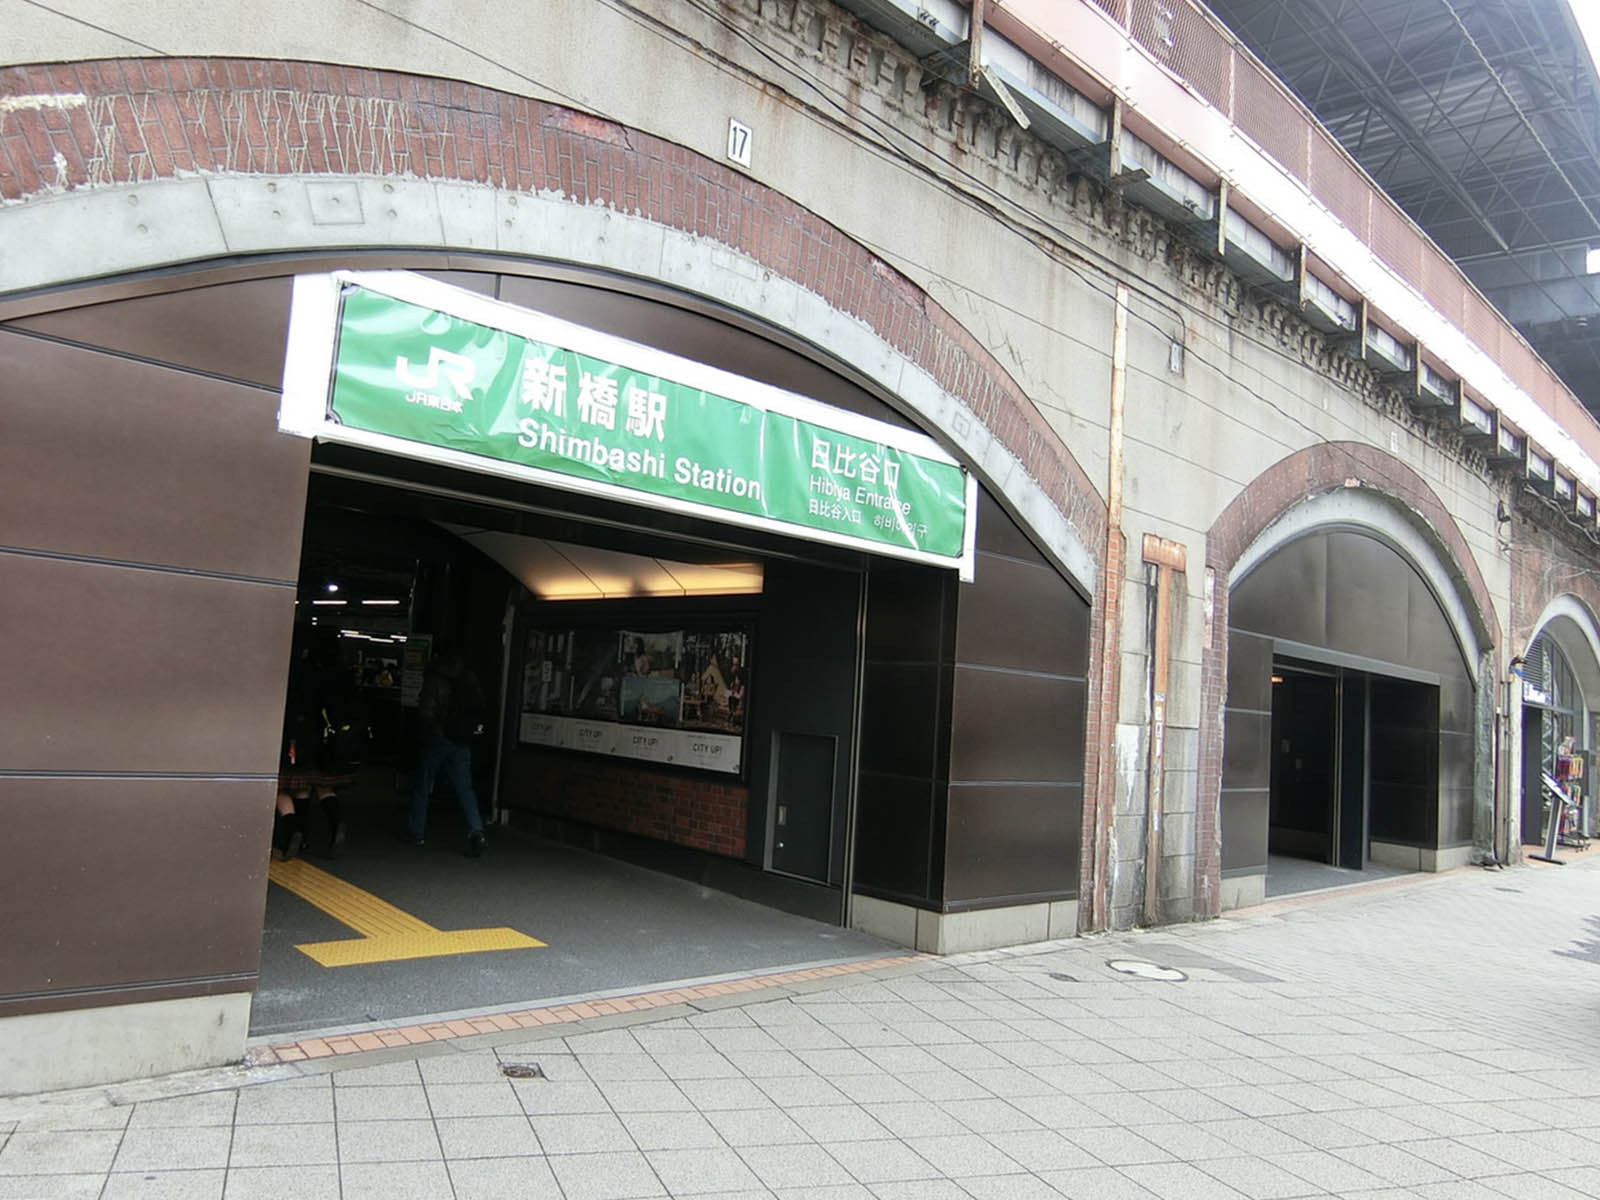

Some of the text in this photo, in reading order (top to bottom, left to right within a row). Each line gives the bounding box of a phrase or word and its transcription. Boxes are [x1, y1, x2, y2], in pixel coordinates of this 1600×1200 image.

[732, 126, 748, 159] 17
[395, 346, 474, 401] JR
[521, 356, 668, 443] 新橋駅
[517, 418, 761, 501] Shimbashi Station
[811, 438, 900, 490] 日比谷口
[809, 474, 851, 502] Hibiya
[808, 498, 863, 524] 日比谷入口
[692, 743, 709, 753] CITY
